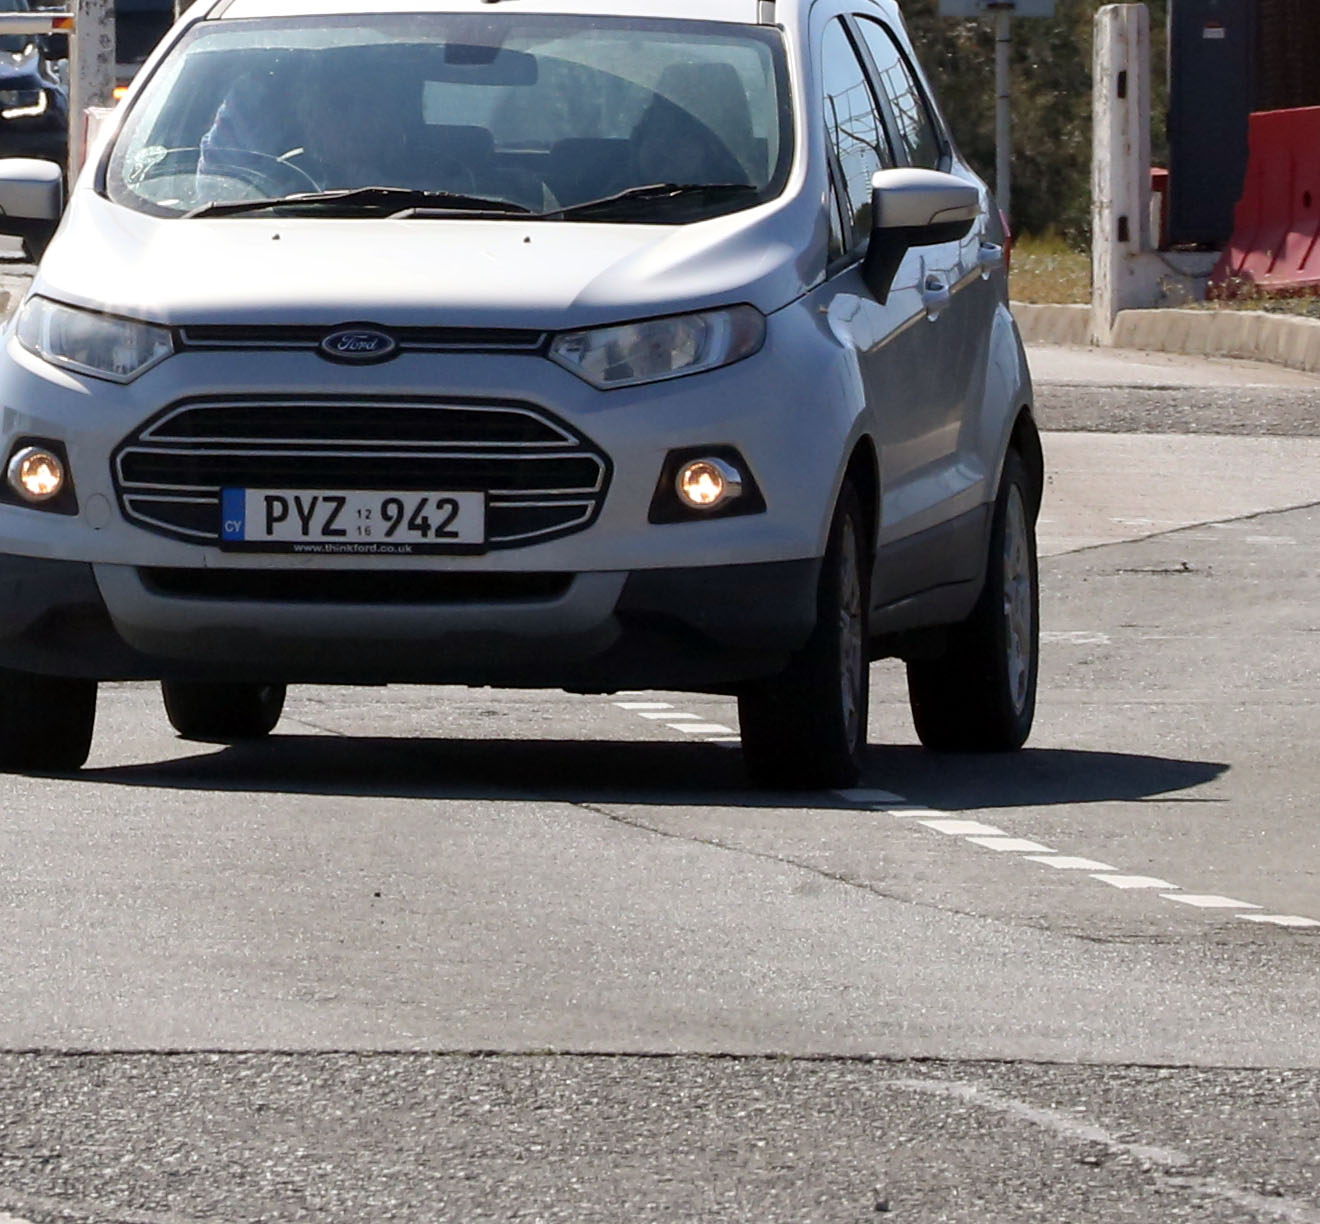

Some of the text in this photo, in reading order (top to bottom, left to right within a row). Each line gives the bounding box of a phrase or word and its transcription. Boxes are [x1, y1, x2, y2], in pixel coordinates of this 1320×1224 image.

[337, 335, 377, 351] Ford
[264, 495, 460, 538] PYZ 942
[224, 521, 242, 533] CY
[293, 544, 413, 554] www.thinkford.co.uk
